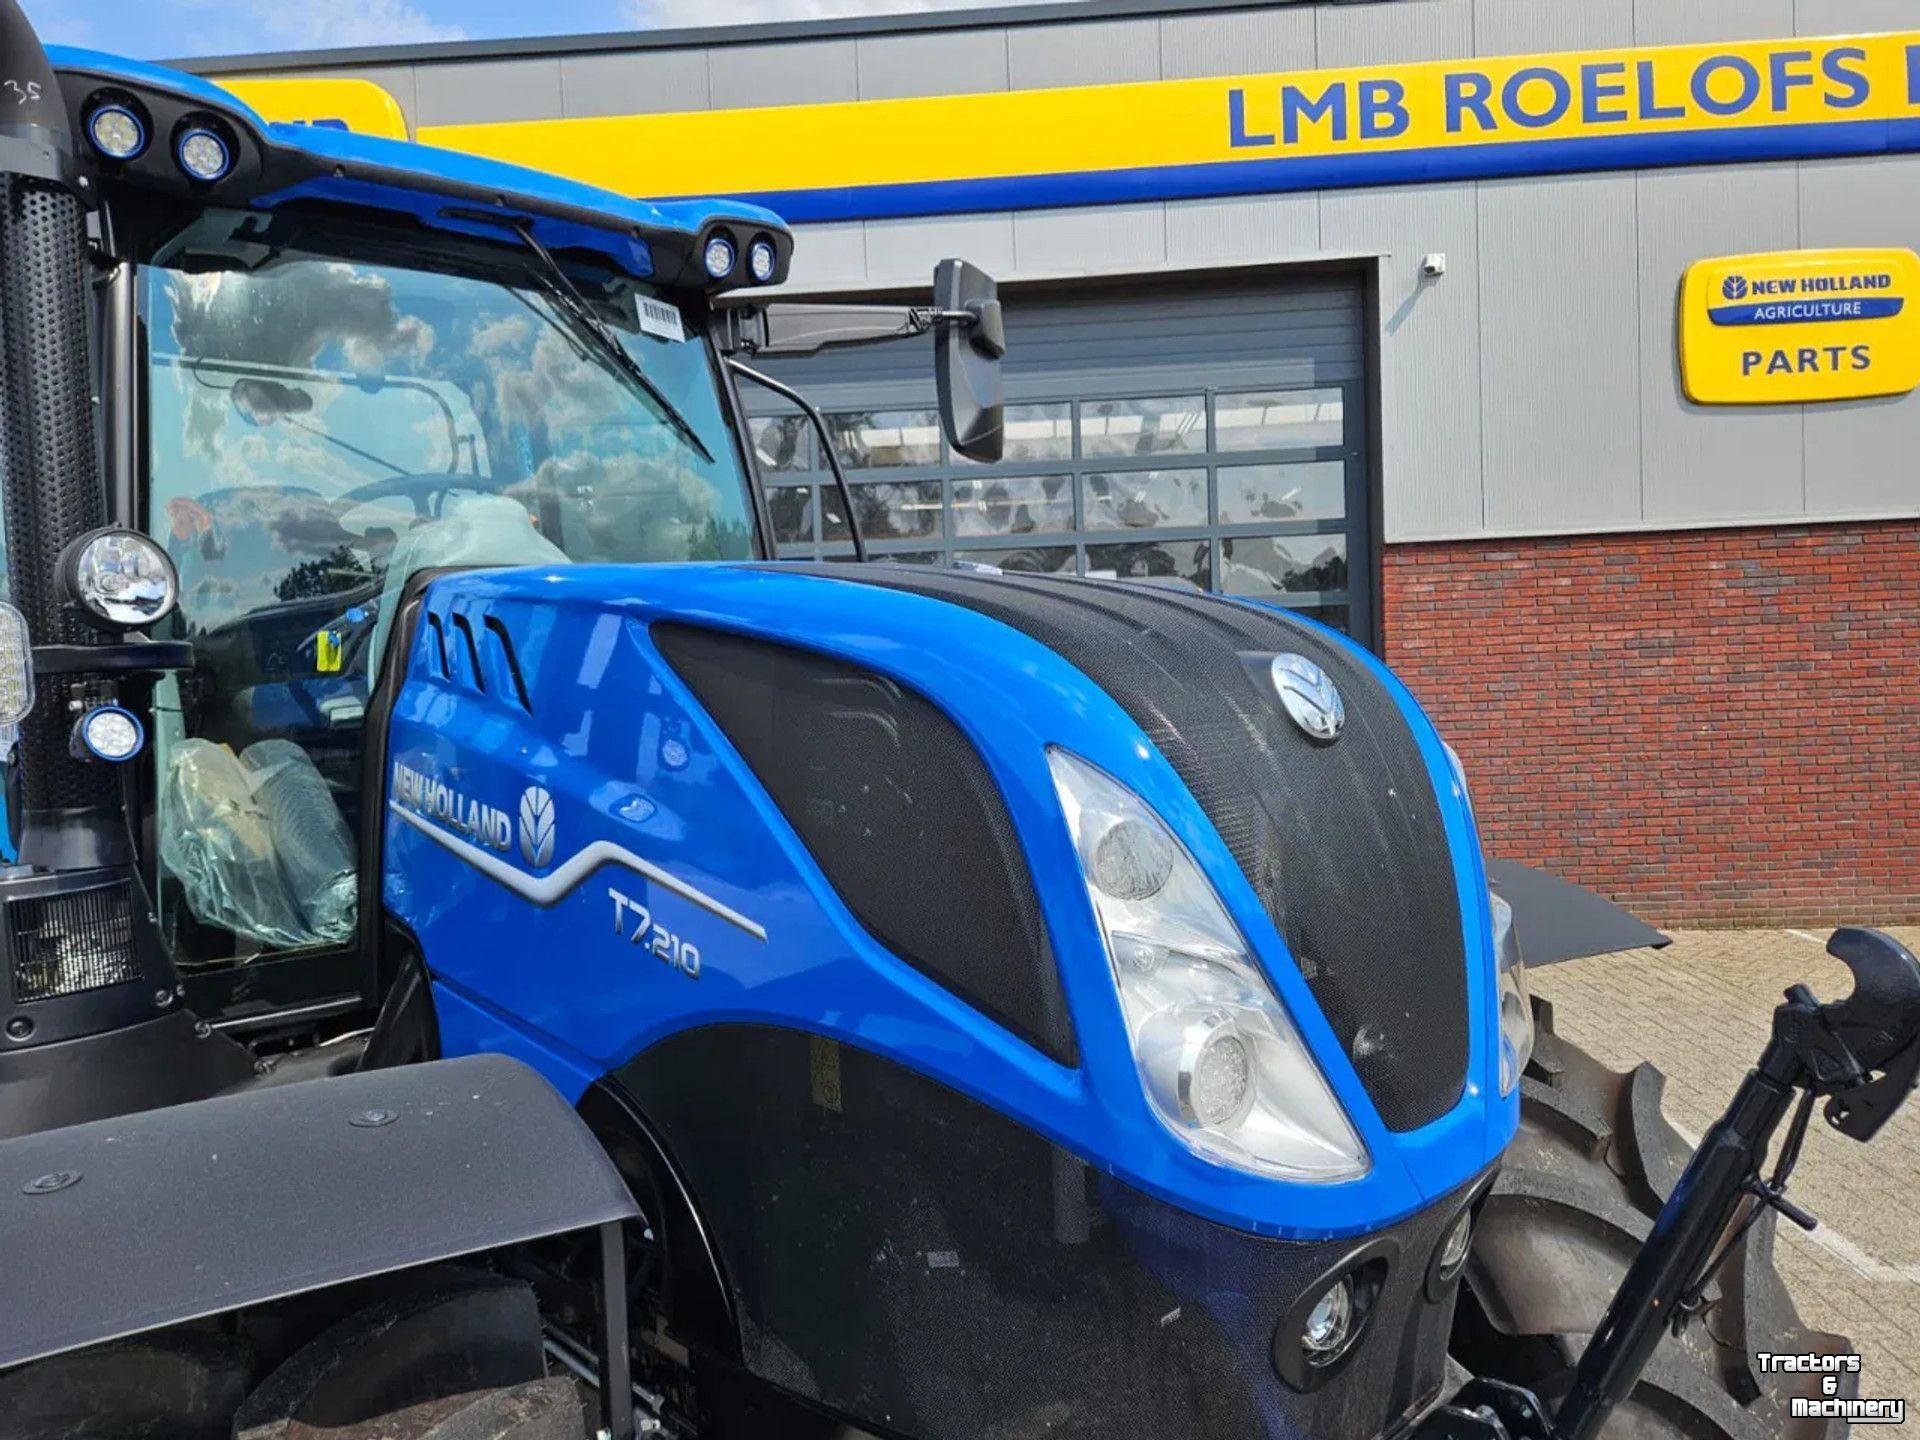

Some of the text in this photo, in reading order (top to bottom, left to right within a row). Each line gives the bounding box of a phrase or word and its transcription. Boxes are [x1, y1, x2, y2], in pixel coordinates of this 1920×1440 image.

[1228, 79, 1410, 148] LMB
[1444, 47, 1870, 133] ROELOFS
[1752, 274, 1891, 295] NEW HOLLAND
[1754, 301, 1861, 320] AGRICULTURE
[1742, 345, 1871, 376] PARTS
[393, 761, 512, 852] NEW HOLLAND
[608, 887, 701, 979] T7.210
